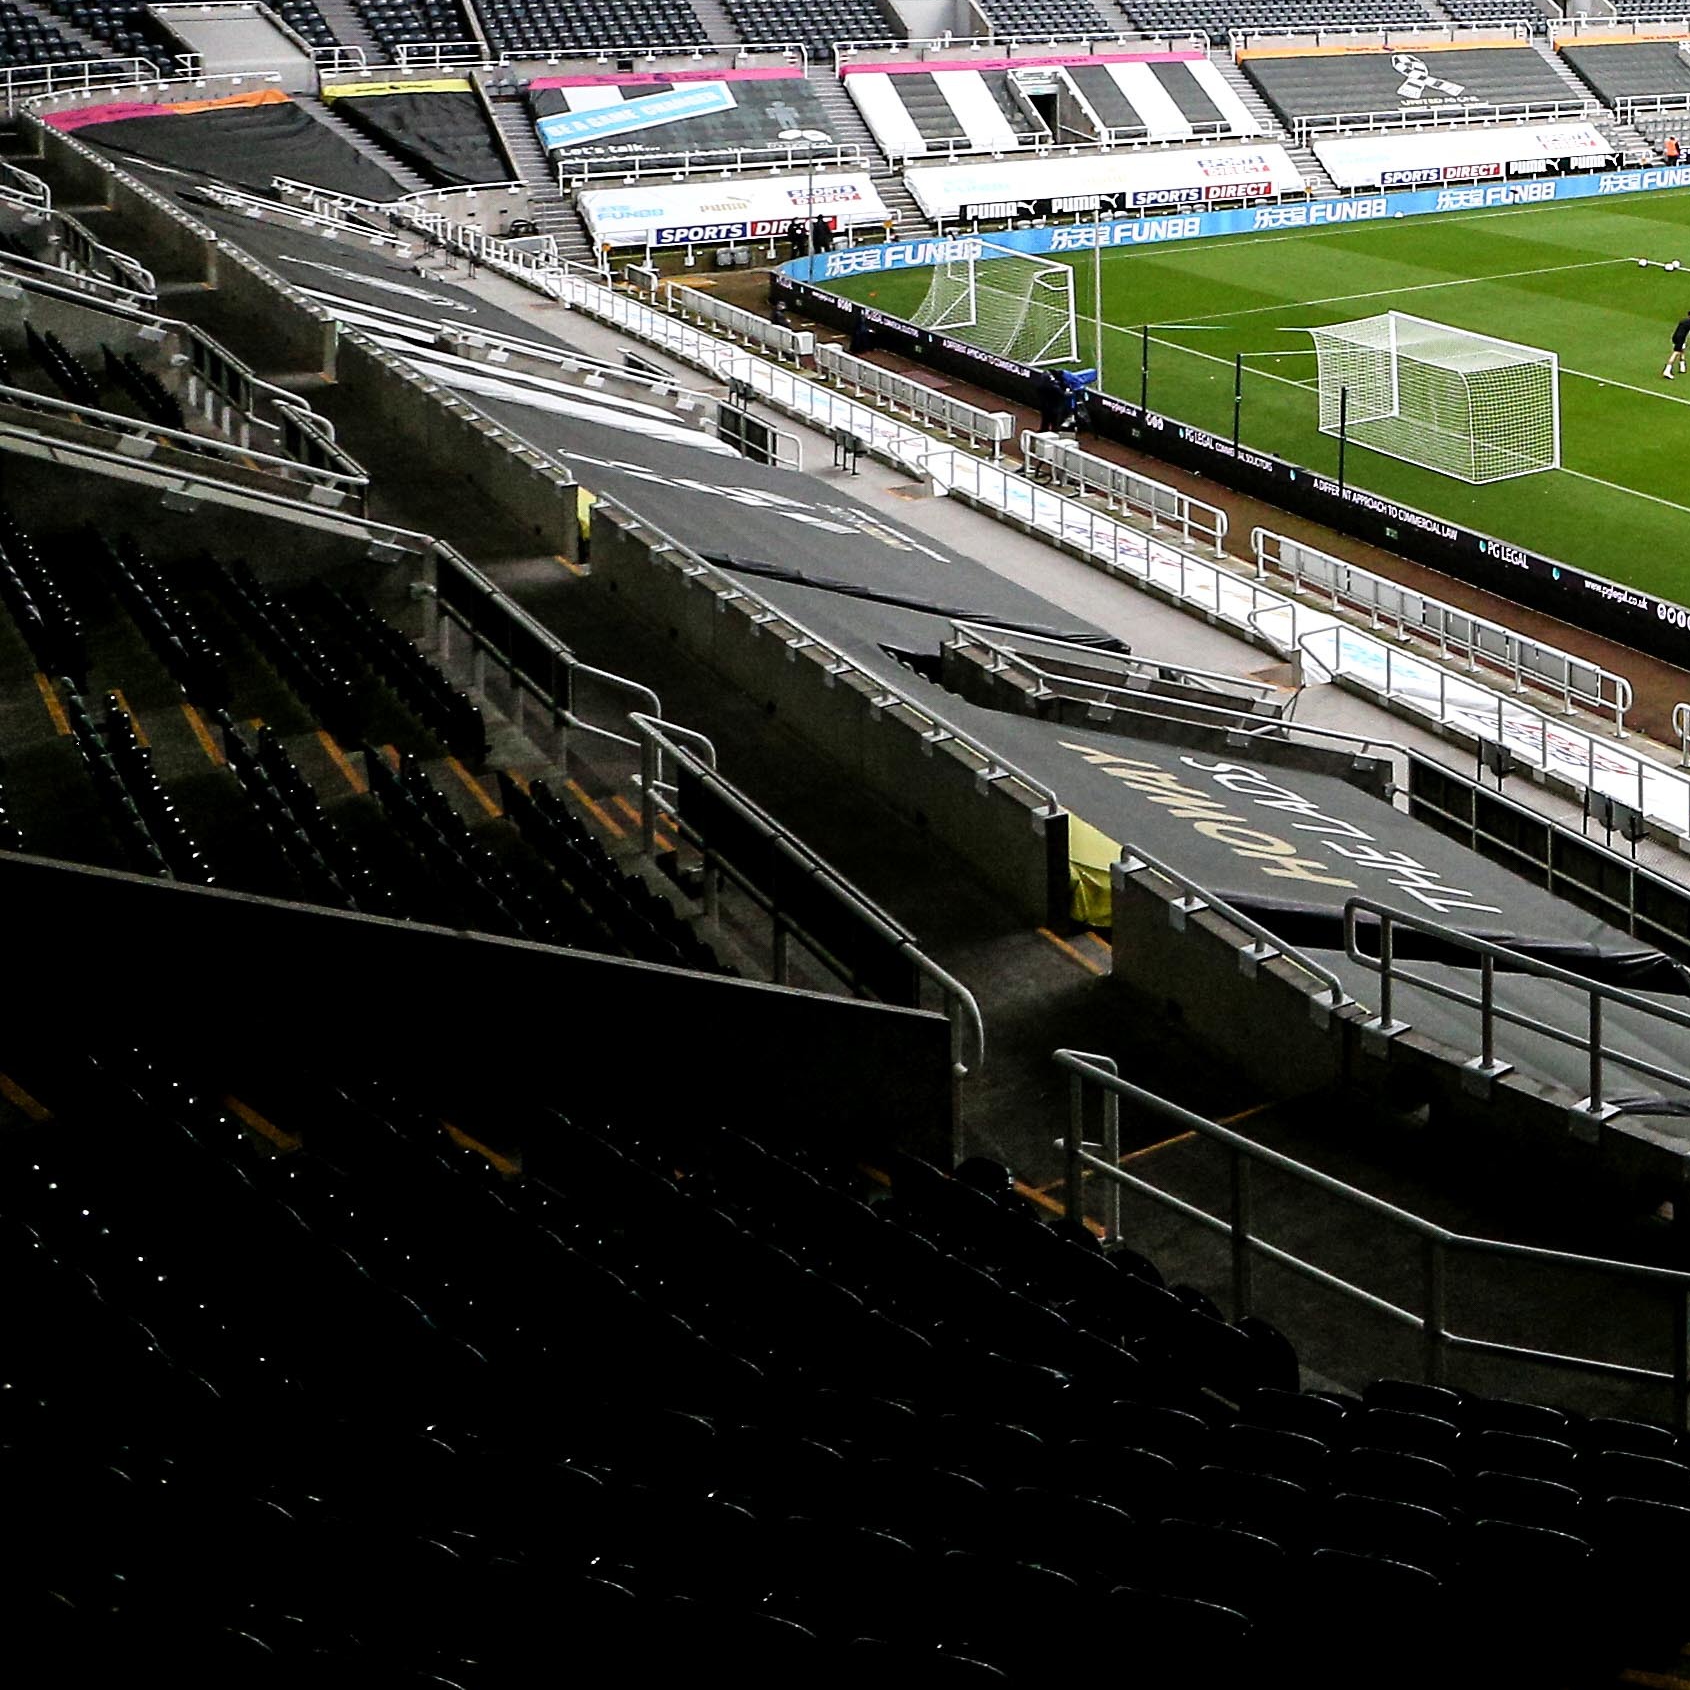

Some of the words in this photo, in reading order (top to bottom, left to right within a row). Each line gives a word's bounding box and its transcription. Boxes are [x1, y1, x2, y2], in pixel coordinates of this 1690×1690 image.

[560, 145, 606, 157] Let's
[1570, 154, 1606, 170] PUMA
[1384, 169, 1439, 185] SPORTS
[1444, 163, 1498, 179] DIRECT
[1509, 159, 1547, 175] PUMA
[1051, 194, 1100, 214] PUMA
[1135, 188, 1199, 207] SPORTS
[1208, 181, 1268, 200] DIRECT
[1485, 181, 1556, 206] FUN88
[967, 201, 1018, 221] PUMA
[1309, 198, 1387, 224] FUN88
[660, 223, 745, 244] SPORTS
[1113, 216, 1202, 245] FUN88
[1319, 480, 1352, 502] DIFFERNT
[1487, 541, 1500, 559] PG
[1500, 545, 1530, 571] LEGAL
[1180, 755, 1378, 842] LADS
[1057, 740, 1359, 889] HOWAY
[1320, 839, 1503, 914] THE
